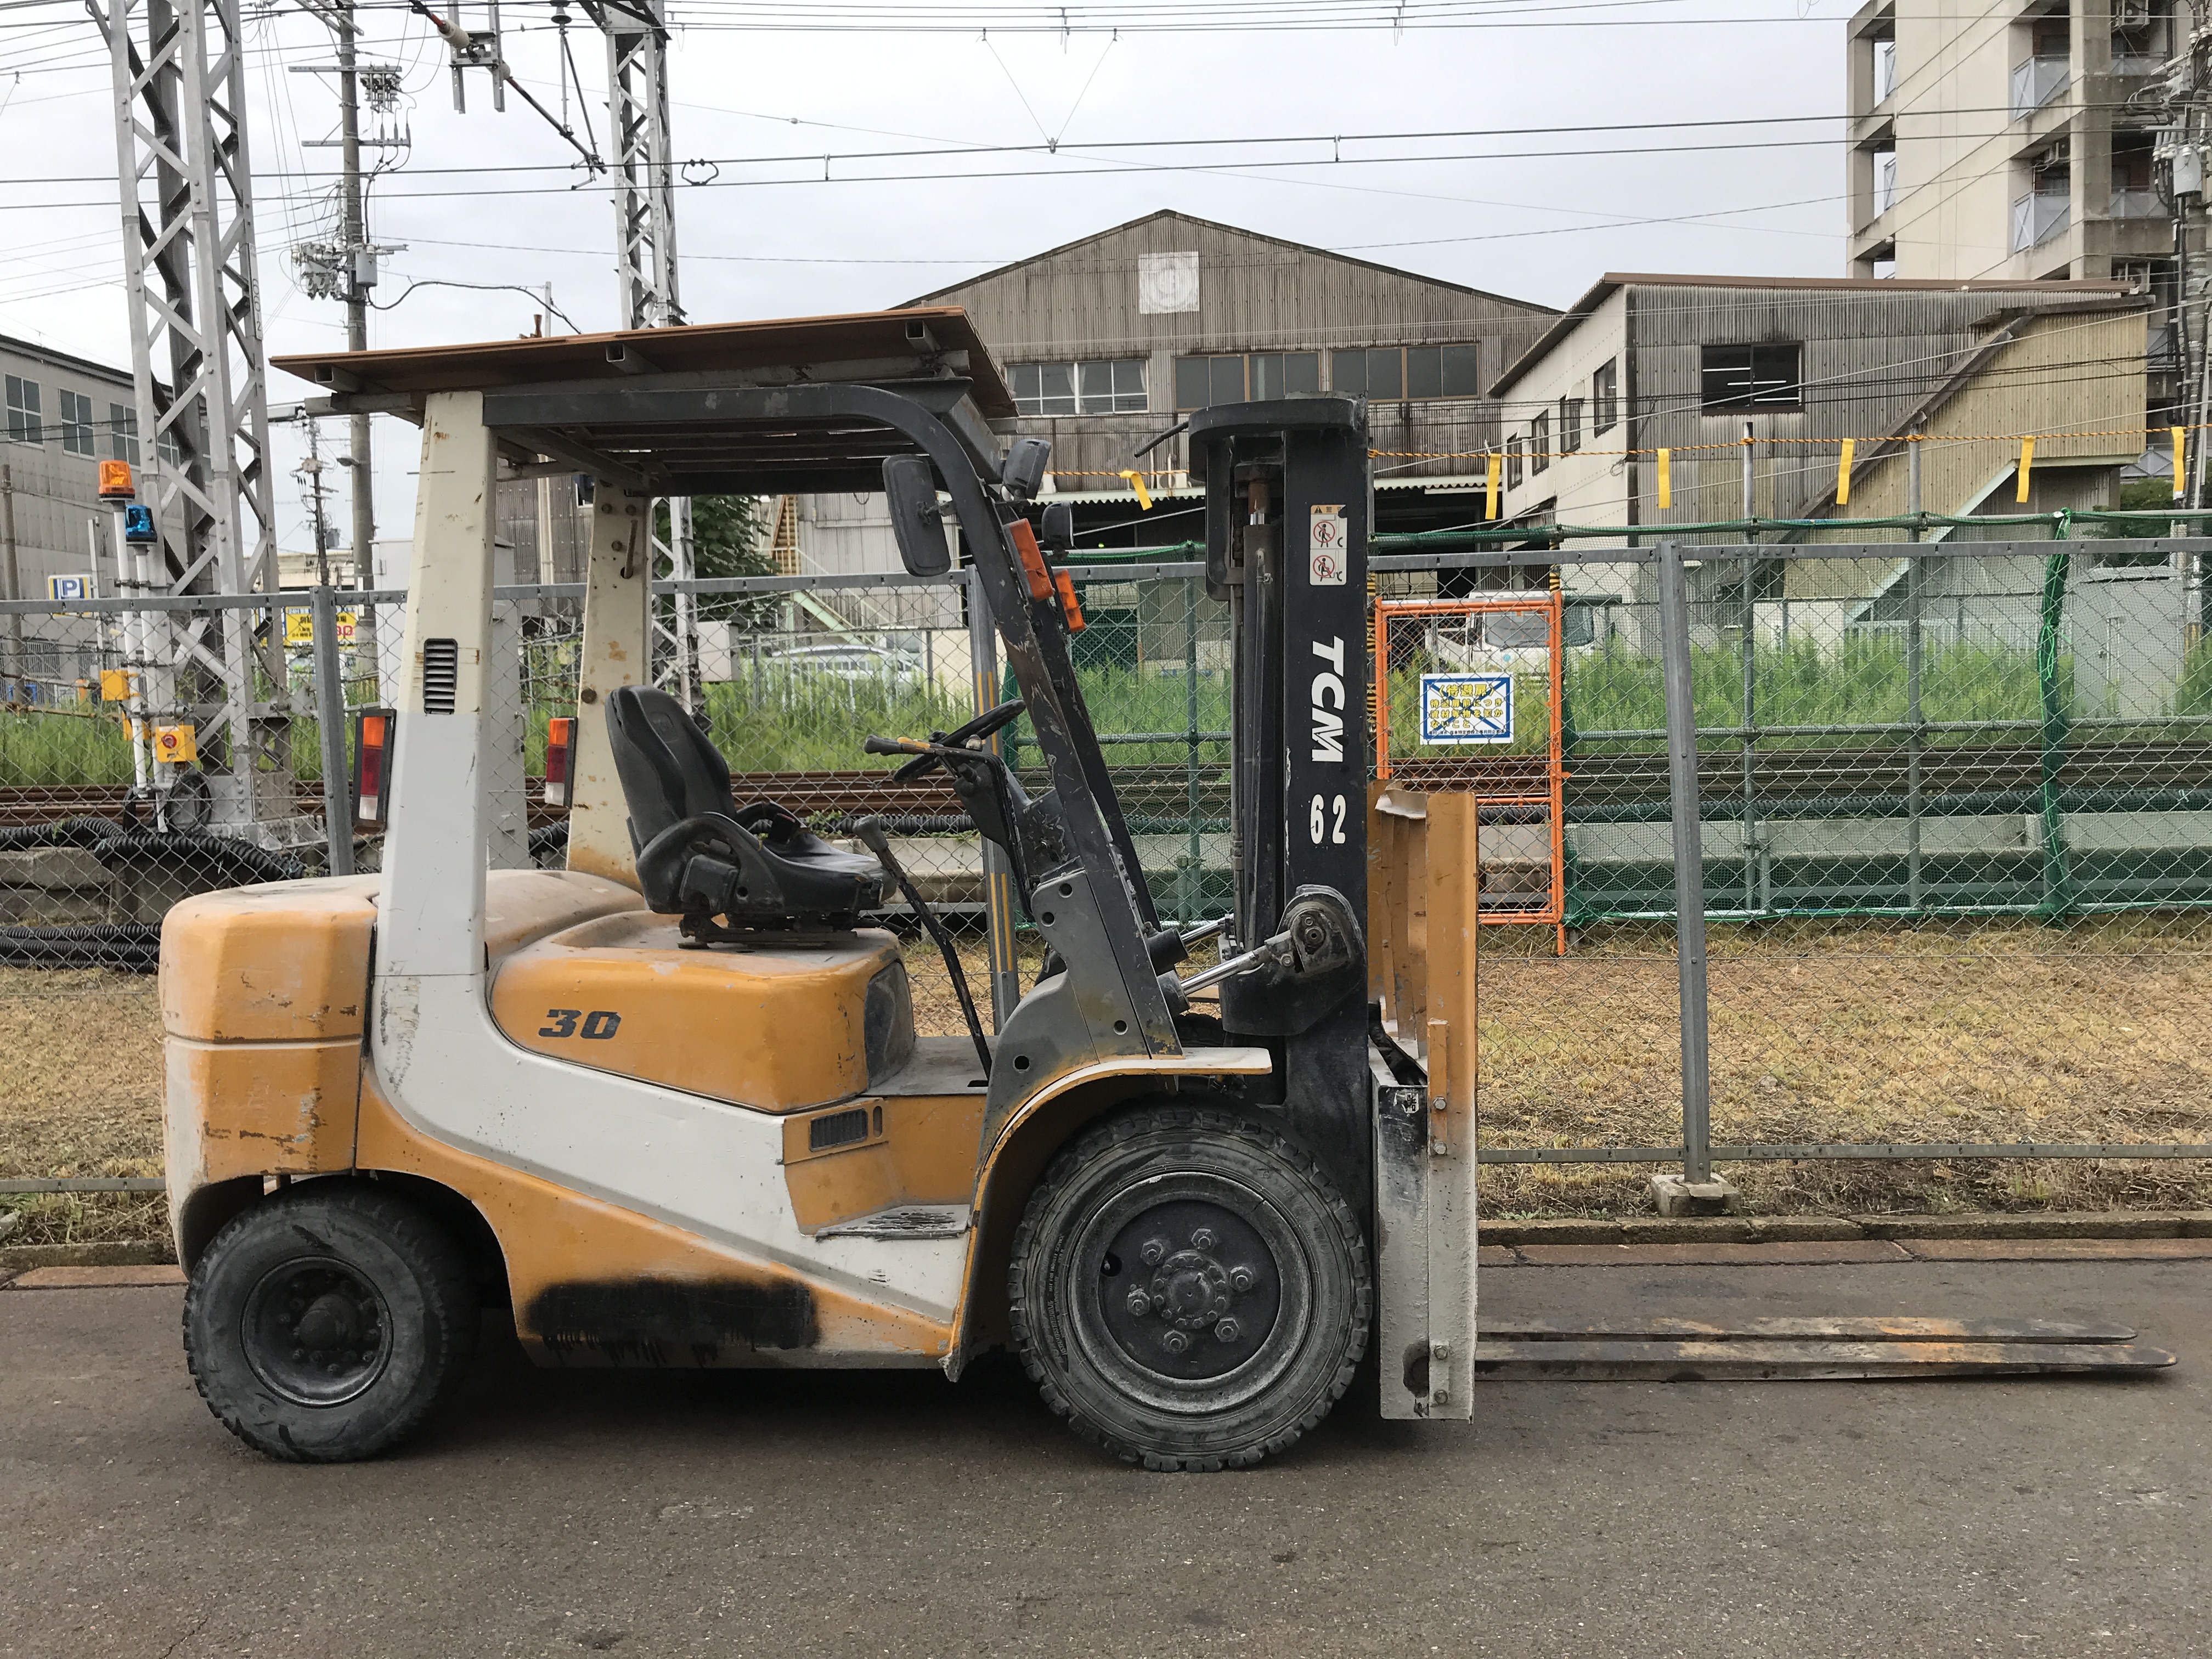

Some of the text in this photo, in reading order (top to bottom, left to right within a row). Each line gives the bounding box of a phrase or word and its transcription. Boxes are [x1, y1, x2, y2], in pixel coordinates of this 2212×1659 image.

[62, 580, 78, 596] P
[1311, 635, 1345, 762] TCM
[1430, 720, 1470, 729] ないこと
[1310, 793, 1346, 845] 62
[538, 1008, 622, 1040] 30
